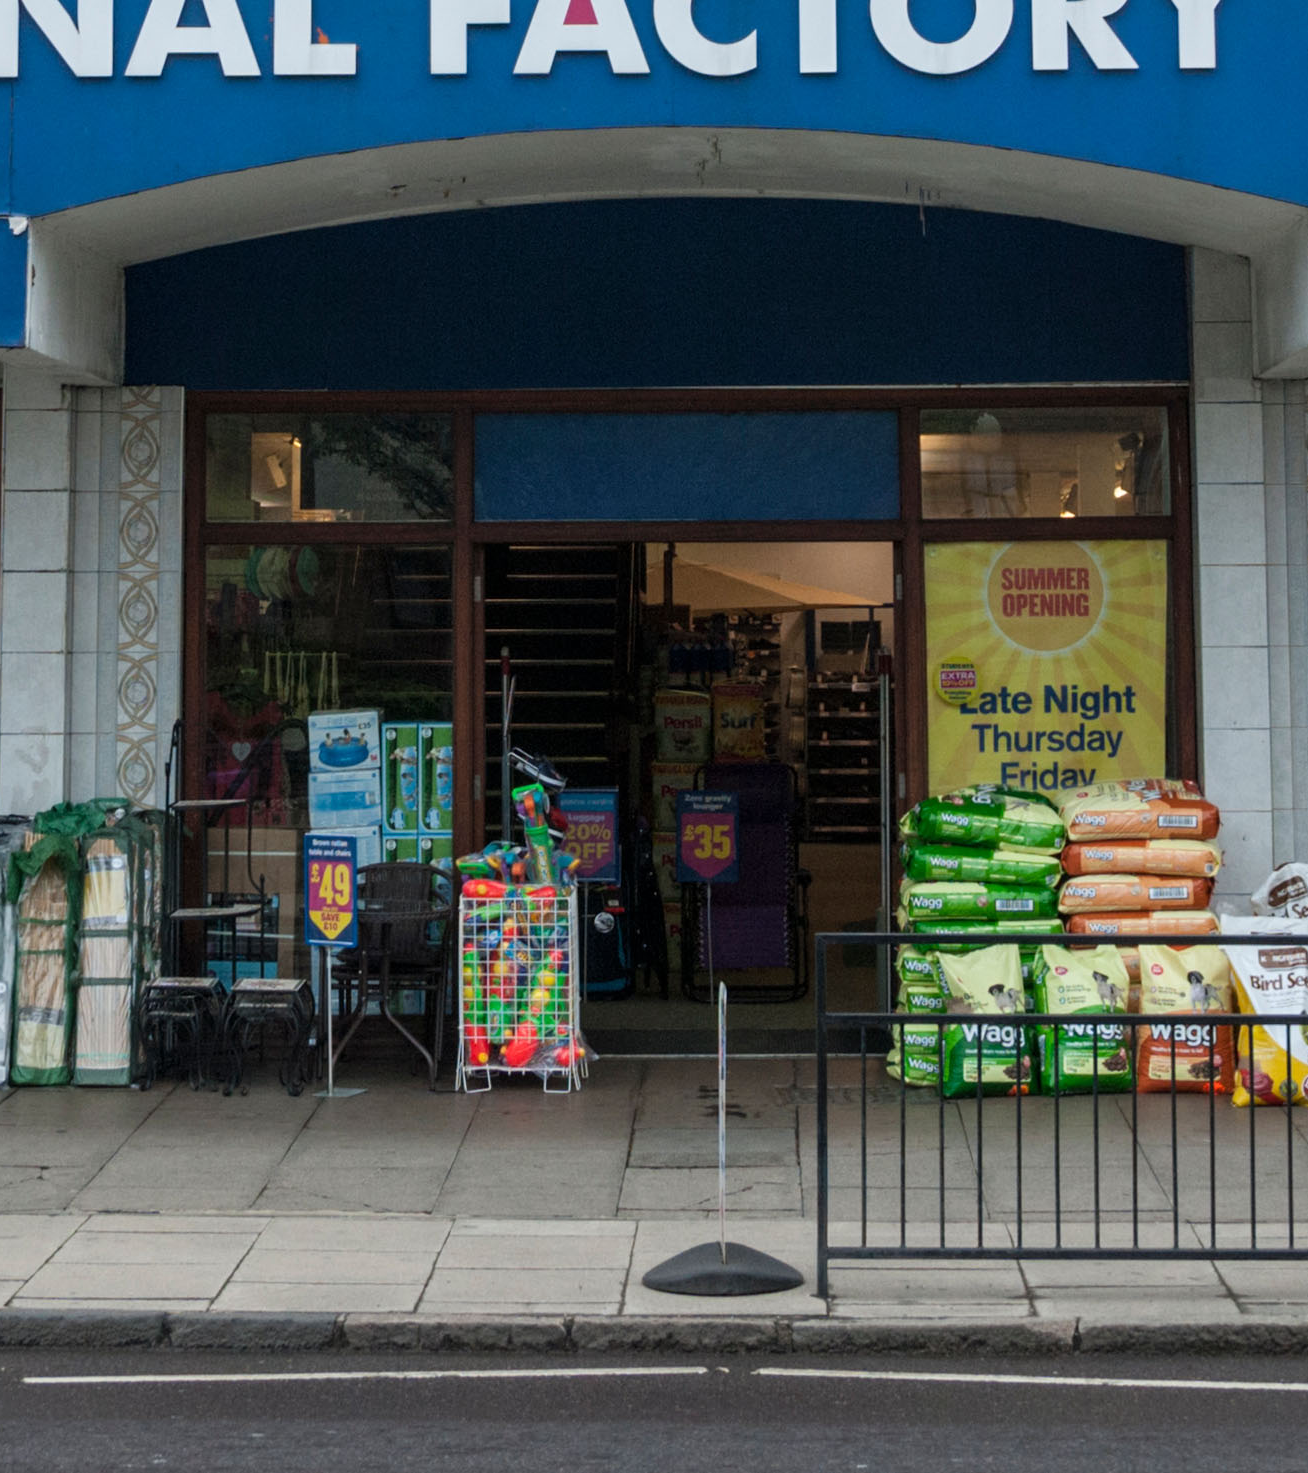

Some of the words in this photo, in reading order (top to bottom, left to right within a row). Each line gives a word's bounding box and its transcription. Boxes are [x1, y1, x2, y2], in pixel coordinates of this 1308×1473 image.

[1001, 567, 1090, 591] SUMMER
[1002, 593, 1090, 617] OPENING
[941, 672, 975, 680] EXTRA
[1043, 684, 1136, 720] Night
[664, 715, 703, 729] Persil
[720, 712, 757, 728] Surf
[971, 723, 1124, 758] Thursday
[1001, 761, 1097, 791] Friday
[684, 793, 703, 801] Zero
[704, 794, 731, 803] gravity
[567, 814, 605, 822] Luggage
[941, 812, 969, 827] Wagg
[1074, 814, 1107, 826] Wagg
[567, 823, 611, 840] 20%
[683, 823, 730, 859] £35
[565, 841, 610, 859] OFF
[1084, 849, 1114, 861] Wagg
[930, 856, 959, 869] Wagg
[311, 863, 350, 906] £49
[1065, 885, 1096, 898] Wagg
[910, 896, 943, 909] Wagg
[321, 912, 340, 921] SAVE
[1088, 921, 1119, 934] Wagg
[1250, 973, 1283, 991] Bird
[910, 995, 943, 1008] Wagg
[904, 1033, 936, 1047] Wagg
